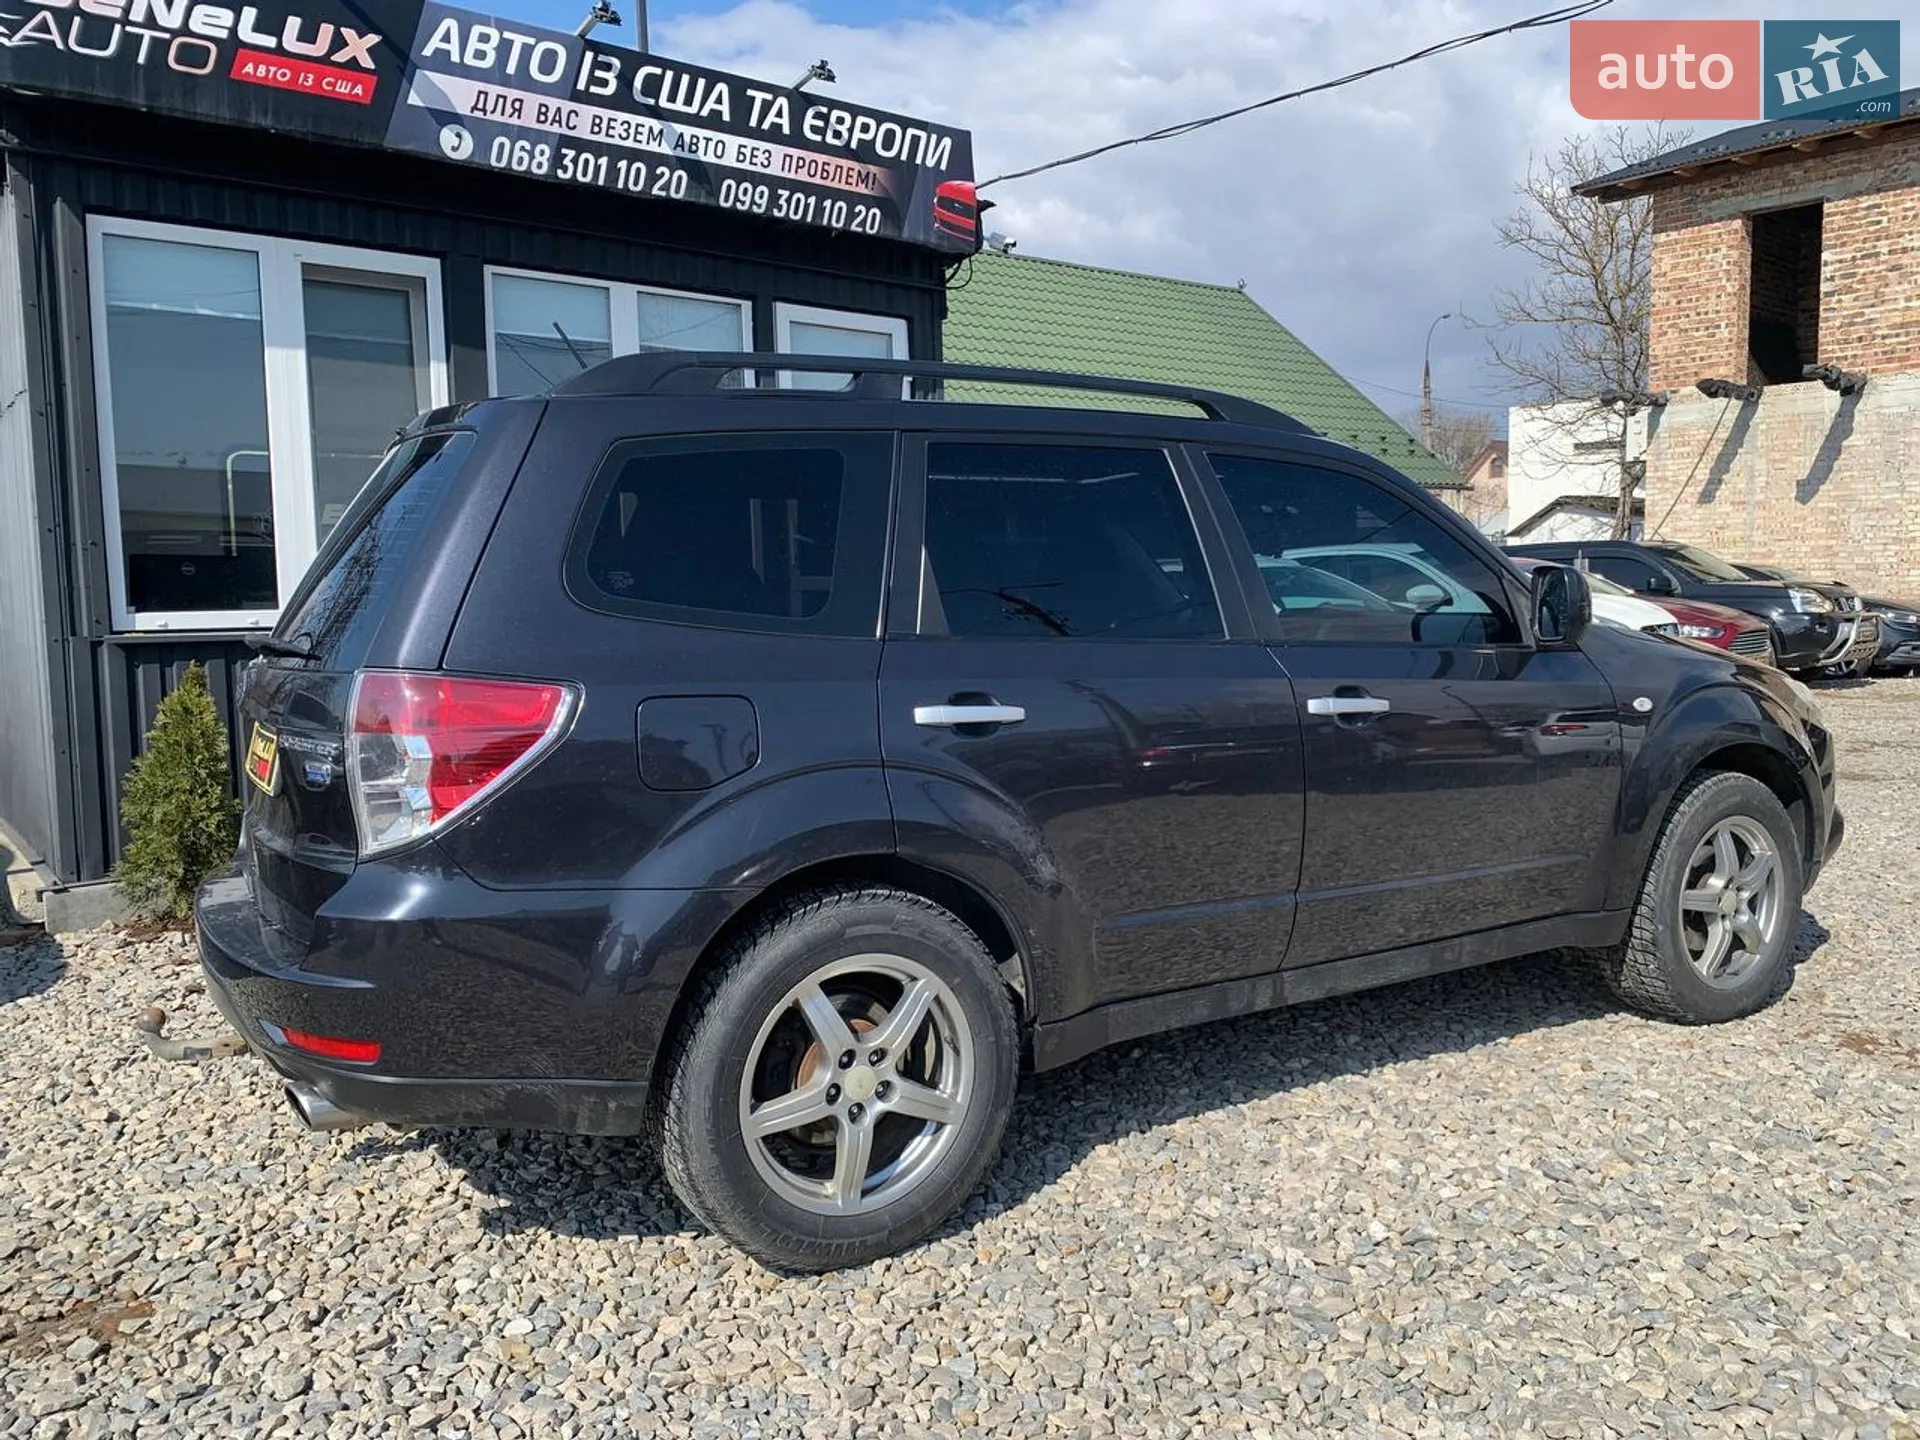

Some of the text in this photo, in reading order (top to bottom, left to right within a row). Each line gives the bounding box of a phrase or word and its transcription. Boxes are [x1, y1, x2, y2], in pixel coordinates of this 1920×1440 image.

[11, 10, 217, 75] AUTO
[242, 62, 291, 82] АВТО
[322, 77, 363, 97] США
[421, 17, 952, 170] АВТО ІЗ США ТА ЄВРОПИ
[470, 90, 877, 191] ДЛЯ ВАС ВЕЗЕМ АВТО БЕЗ ПРОБЛЕМ!
[490, 136, 688, 200] 068 301 10 20
[719, 179, 881, 235] 099 301 10 20
